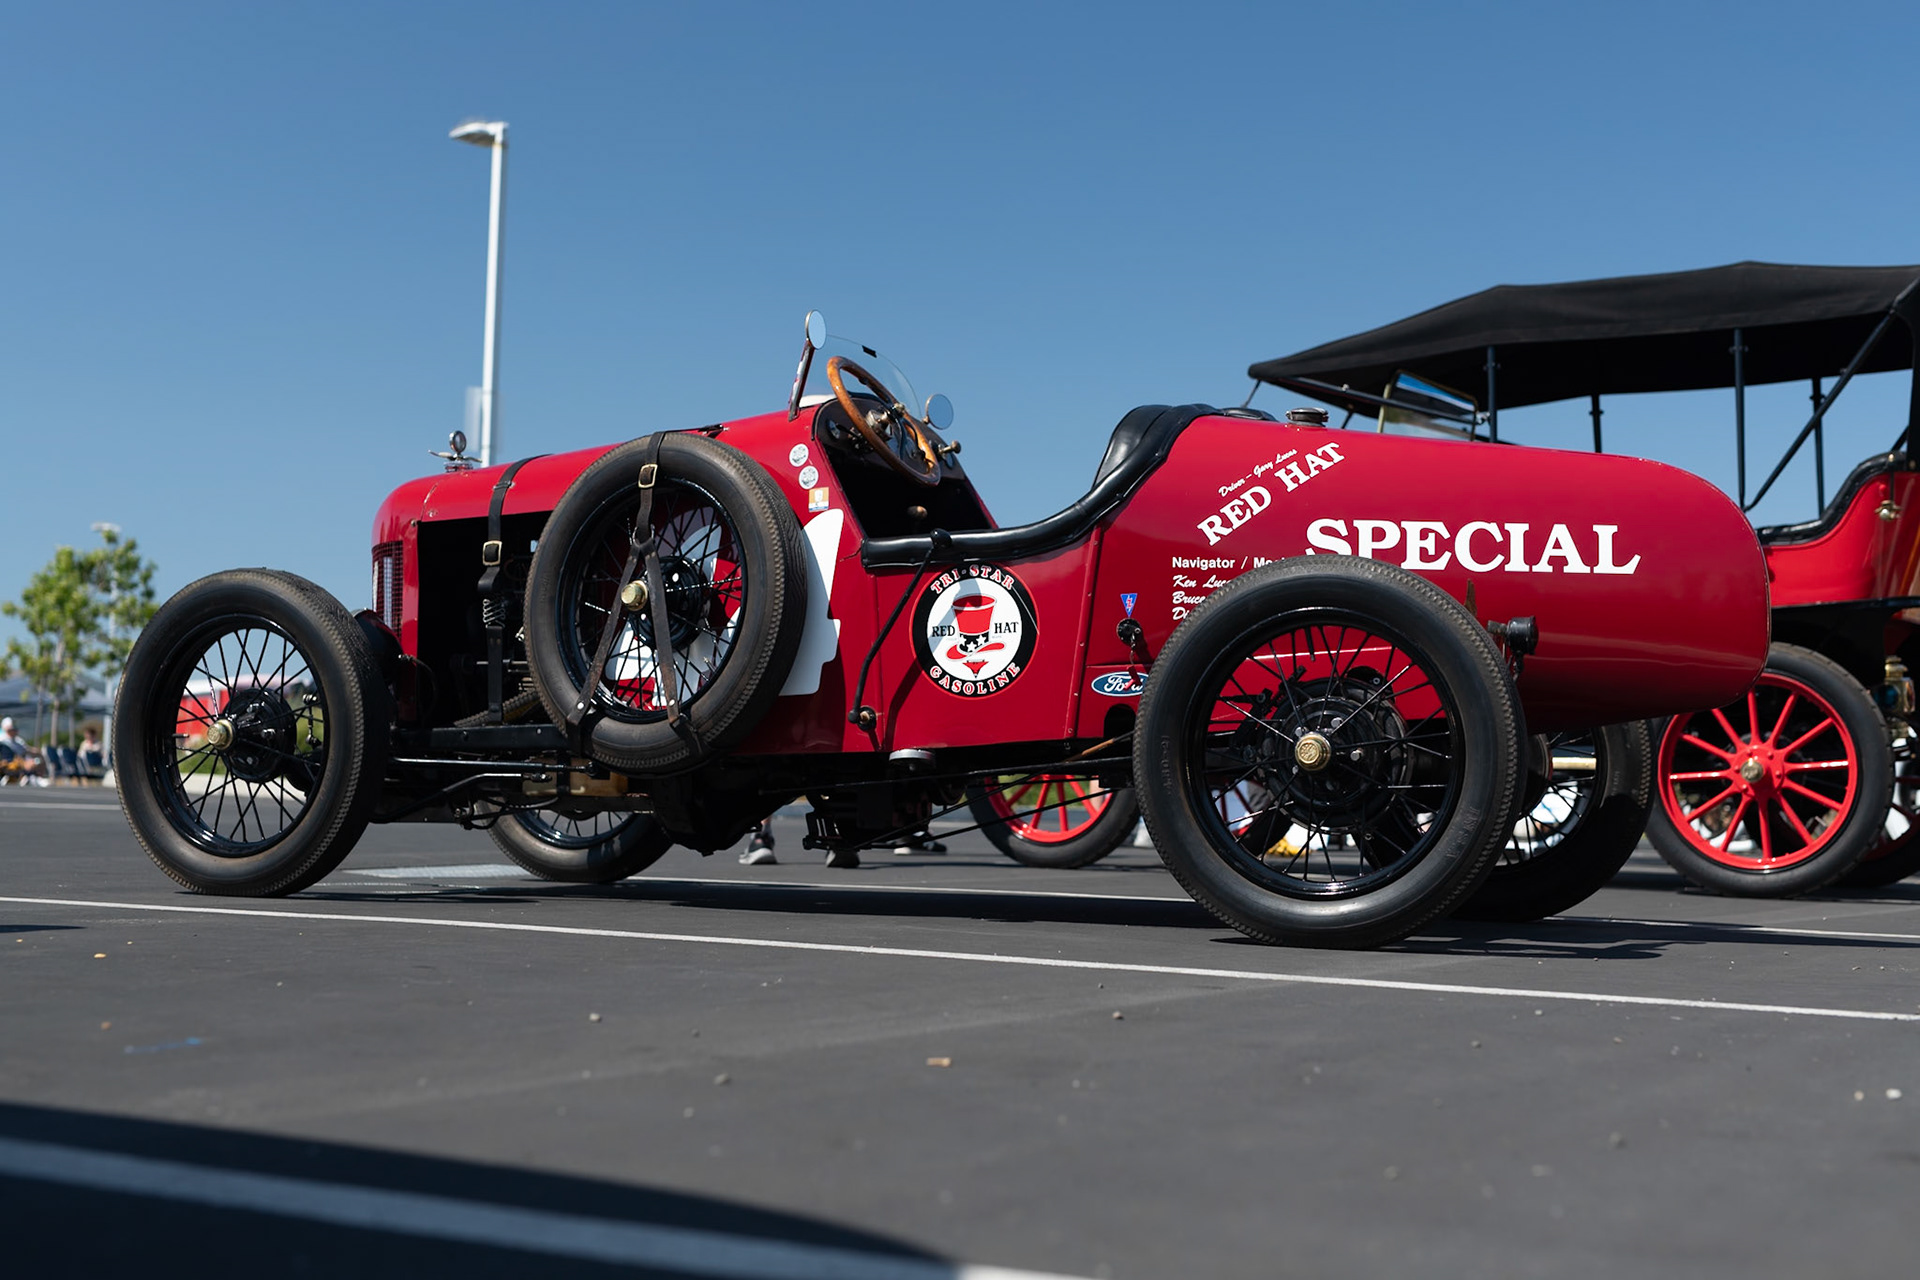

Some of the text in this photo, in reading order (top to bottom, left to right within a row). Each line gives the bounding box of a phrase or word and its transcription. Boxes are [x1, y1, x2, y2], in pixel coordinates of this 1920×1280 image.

[1197, 442, 1345, 546] RED HAT
[1218, 478, 1246, 497] Driver
[1253, 461, 1274, 478] Gary
[1305, 518, 1642, 575] SPECIAL
[1172, 557, 1236, 571] Navigator
[1172, 574, 1232, 588] Ken Luc
[931, 621, 1019, 637] RED HAT
[930, 662, 1021, 695] GASOLINE
